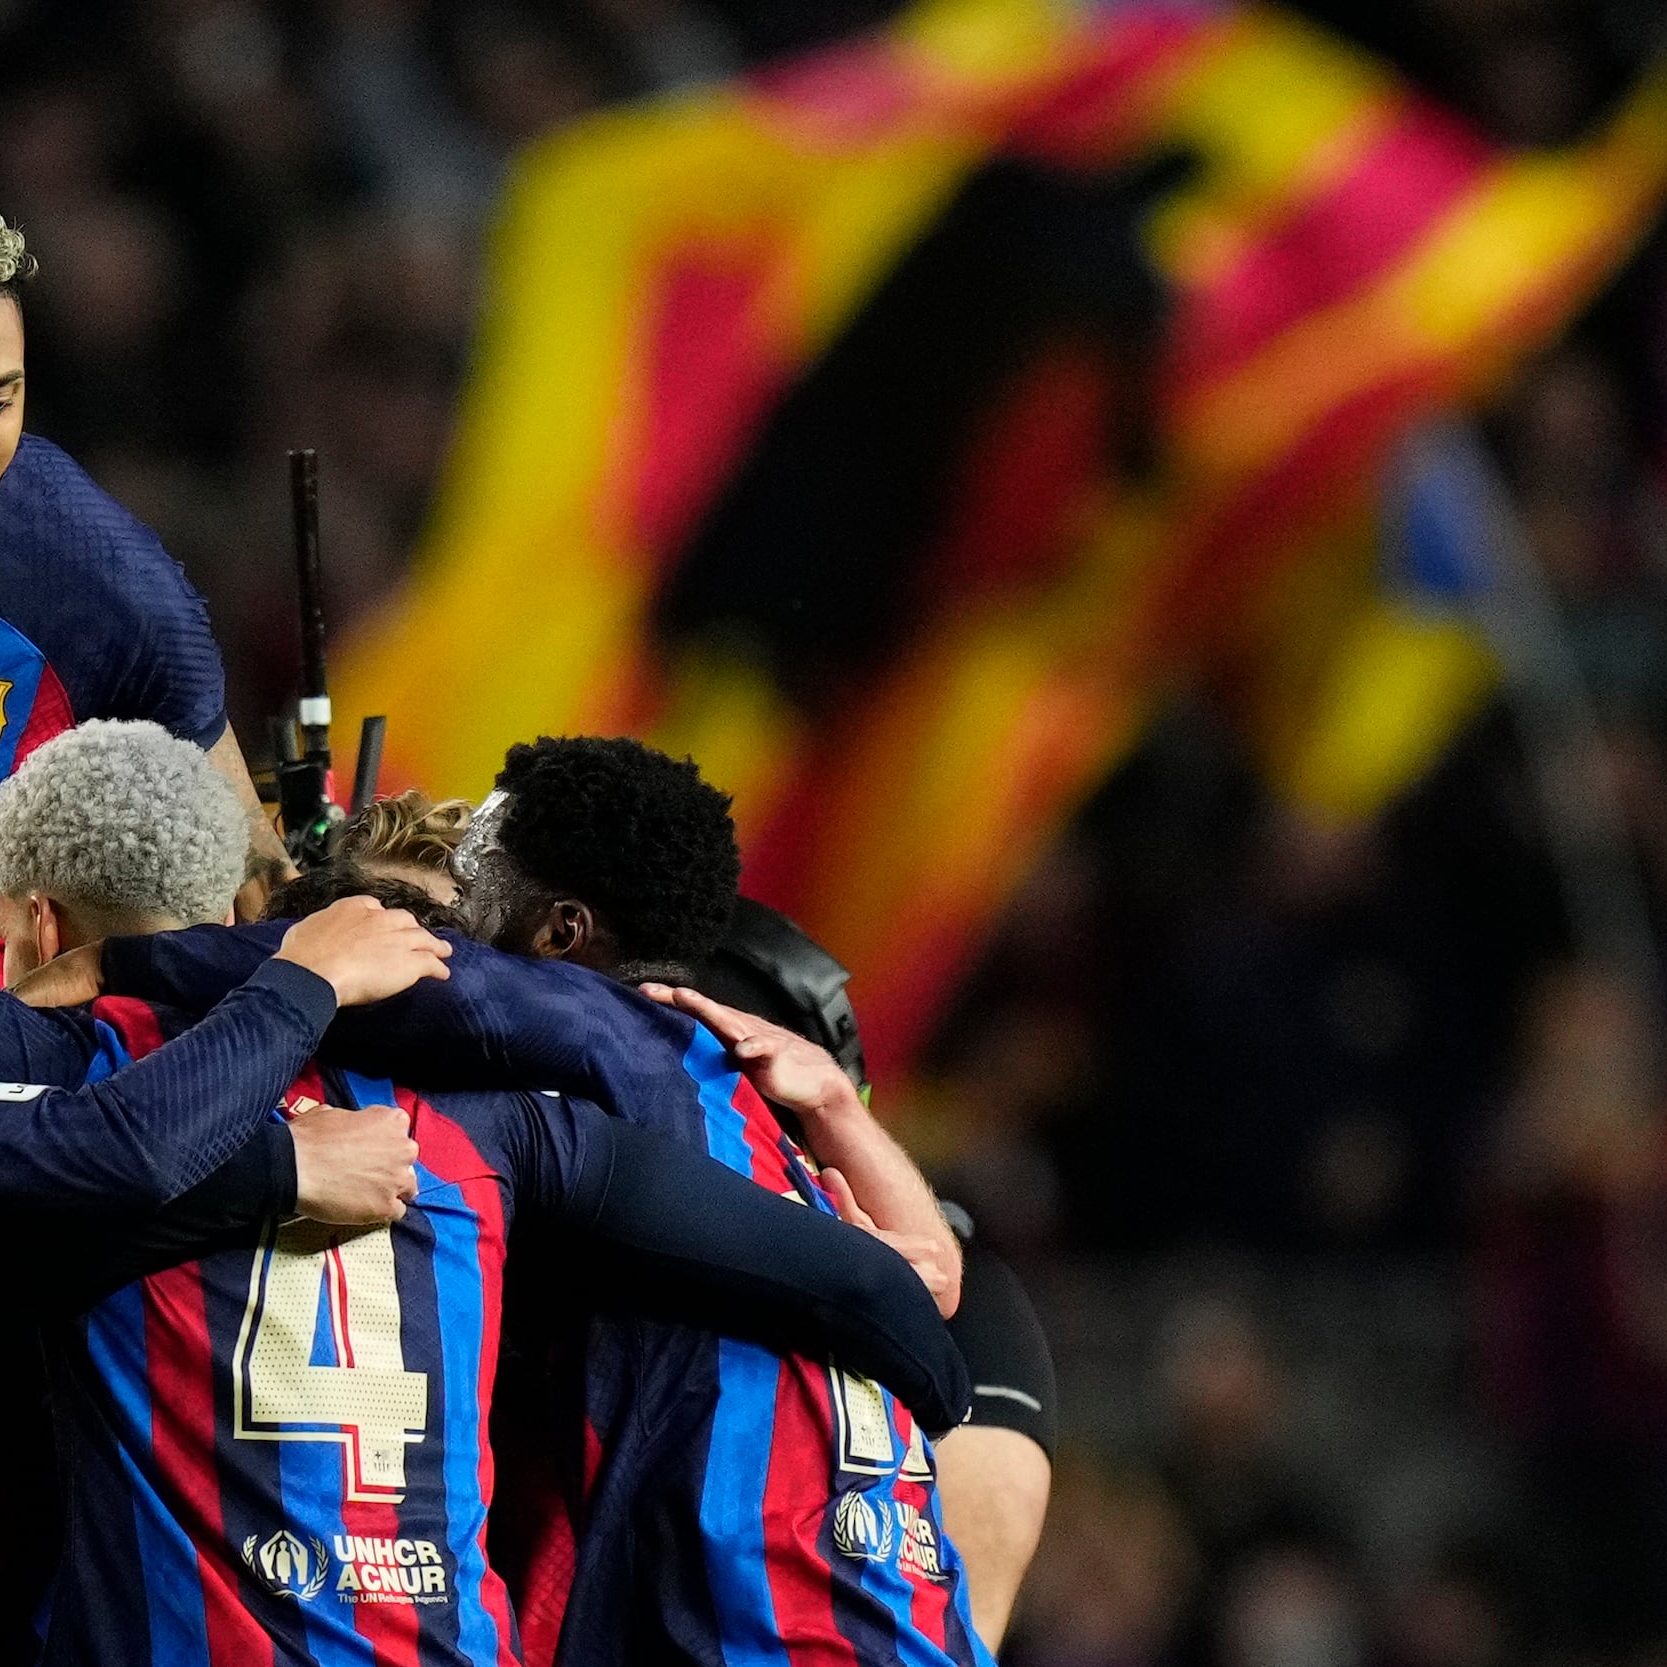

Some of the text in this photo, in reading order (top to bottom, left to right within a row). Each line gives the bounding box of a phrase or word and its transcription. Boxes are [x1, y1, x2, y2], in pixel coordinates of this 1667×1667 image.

[234, 1215, 427, 1503] 4
[333, 1535, 443, 1567] UNHCR
[335, 1563, 446, 1594] ACNUR
[338, 1593, 358, 1603] The
[360, 1593, 377, 1603] UN
